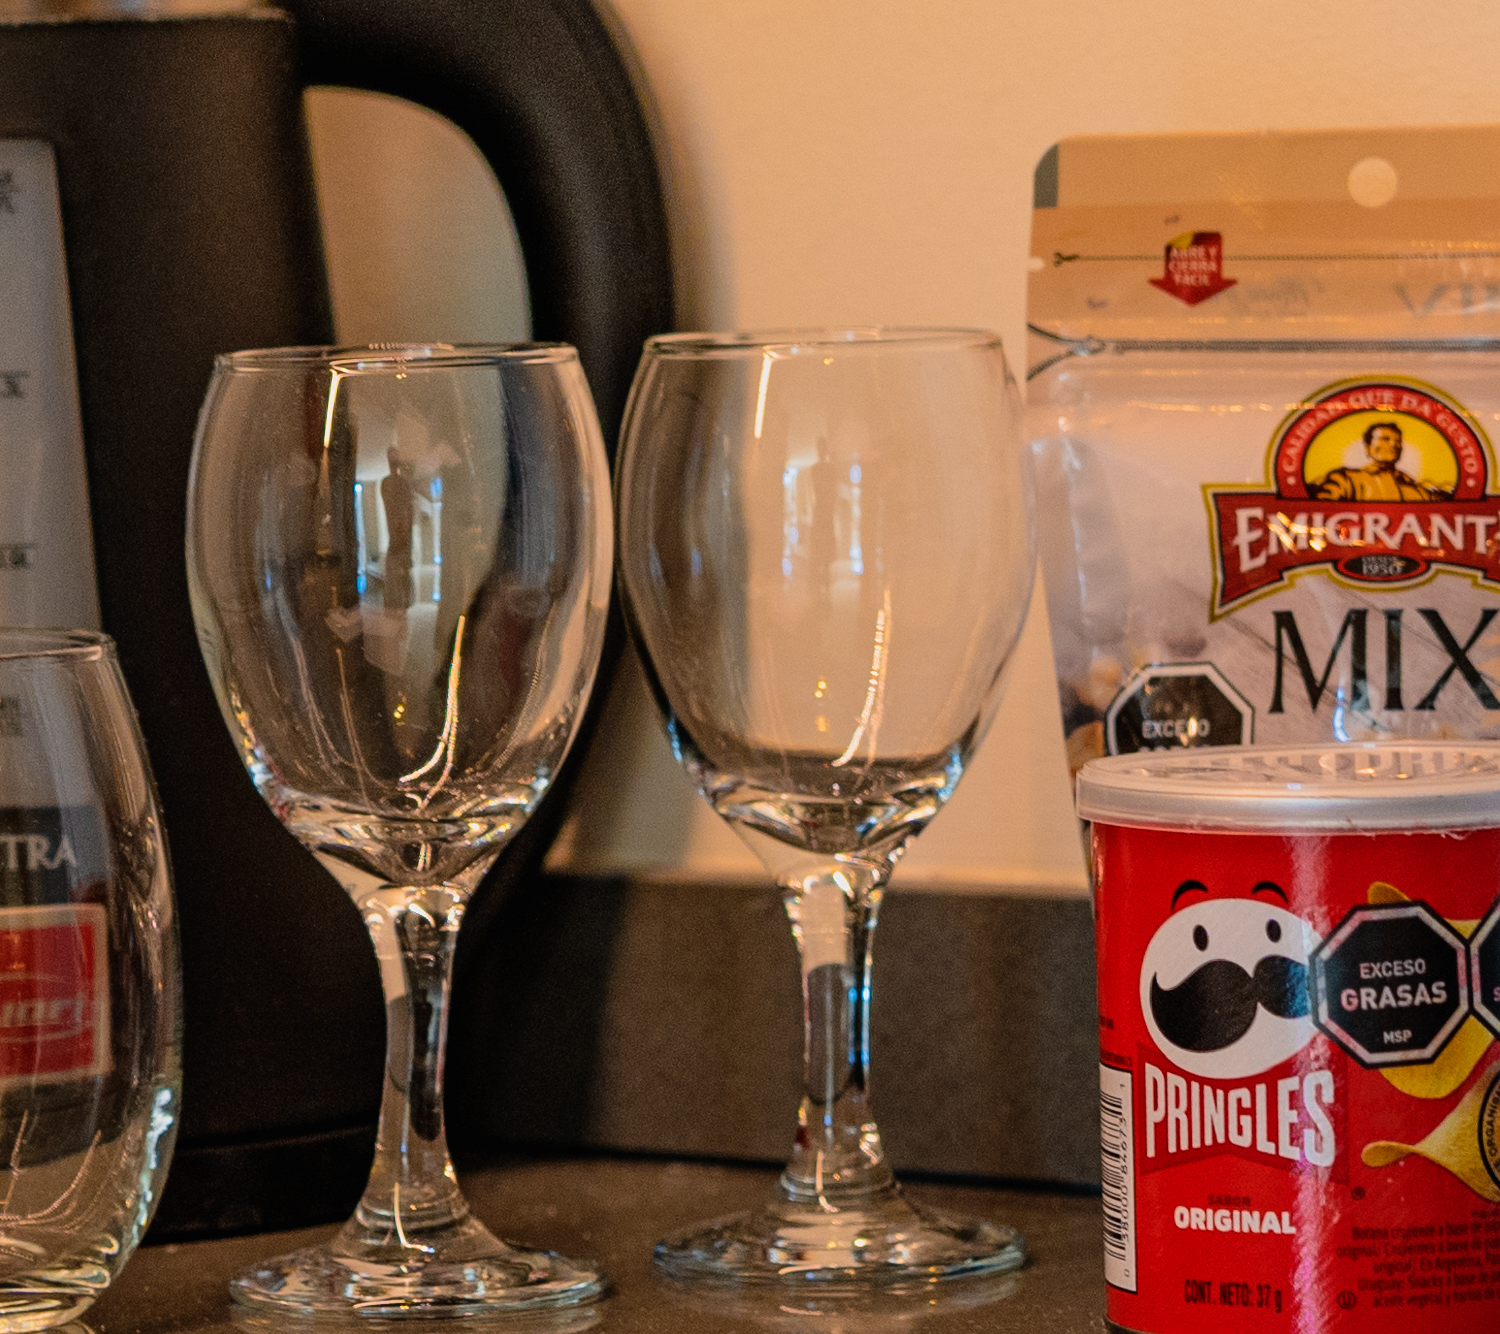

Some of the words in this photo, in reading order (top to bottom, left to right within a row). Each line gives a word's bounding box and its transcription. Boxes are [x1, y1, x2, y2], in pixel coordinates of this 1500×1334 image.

[1350, 390, 1394, 407] QUE
[1402, 394, 1432, 416] DA
[1436, 414, 1478, 473] GUSTO
[1142, 719, 1210, 739] EXCEO
[1359, 958, 1426, 979] EXCESO
[1340, 981, 1447, 1012] GRASAS
[1383, 1030, 1412, 1044] MSP
[1144, 1061, 1336, 1167] PRINGLES
[1174, 1205, 1297, 1235] ORIGINAL
[1185, 1279, 1216, 1306] CONT.
[1219, 1282, 1253, 1307] NETO:
[1256, 1284, 1271, 1308] 37
[1275, 1289, 1283, 1313] g
